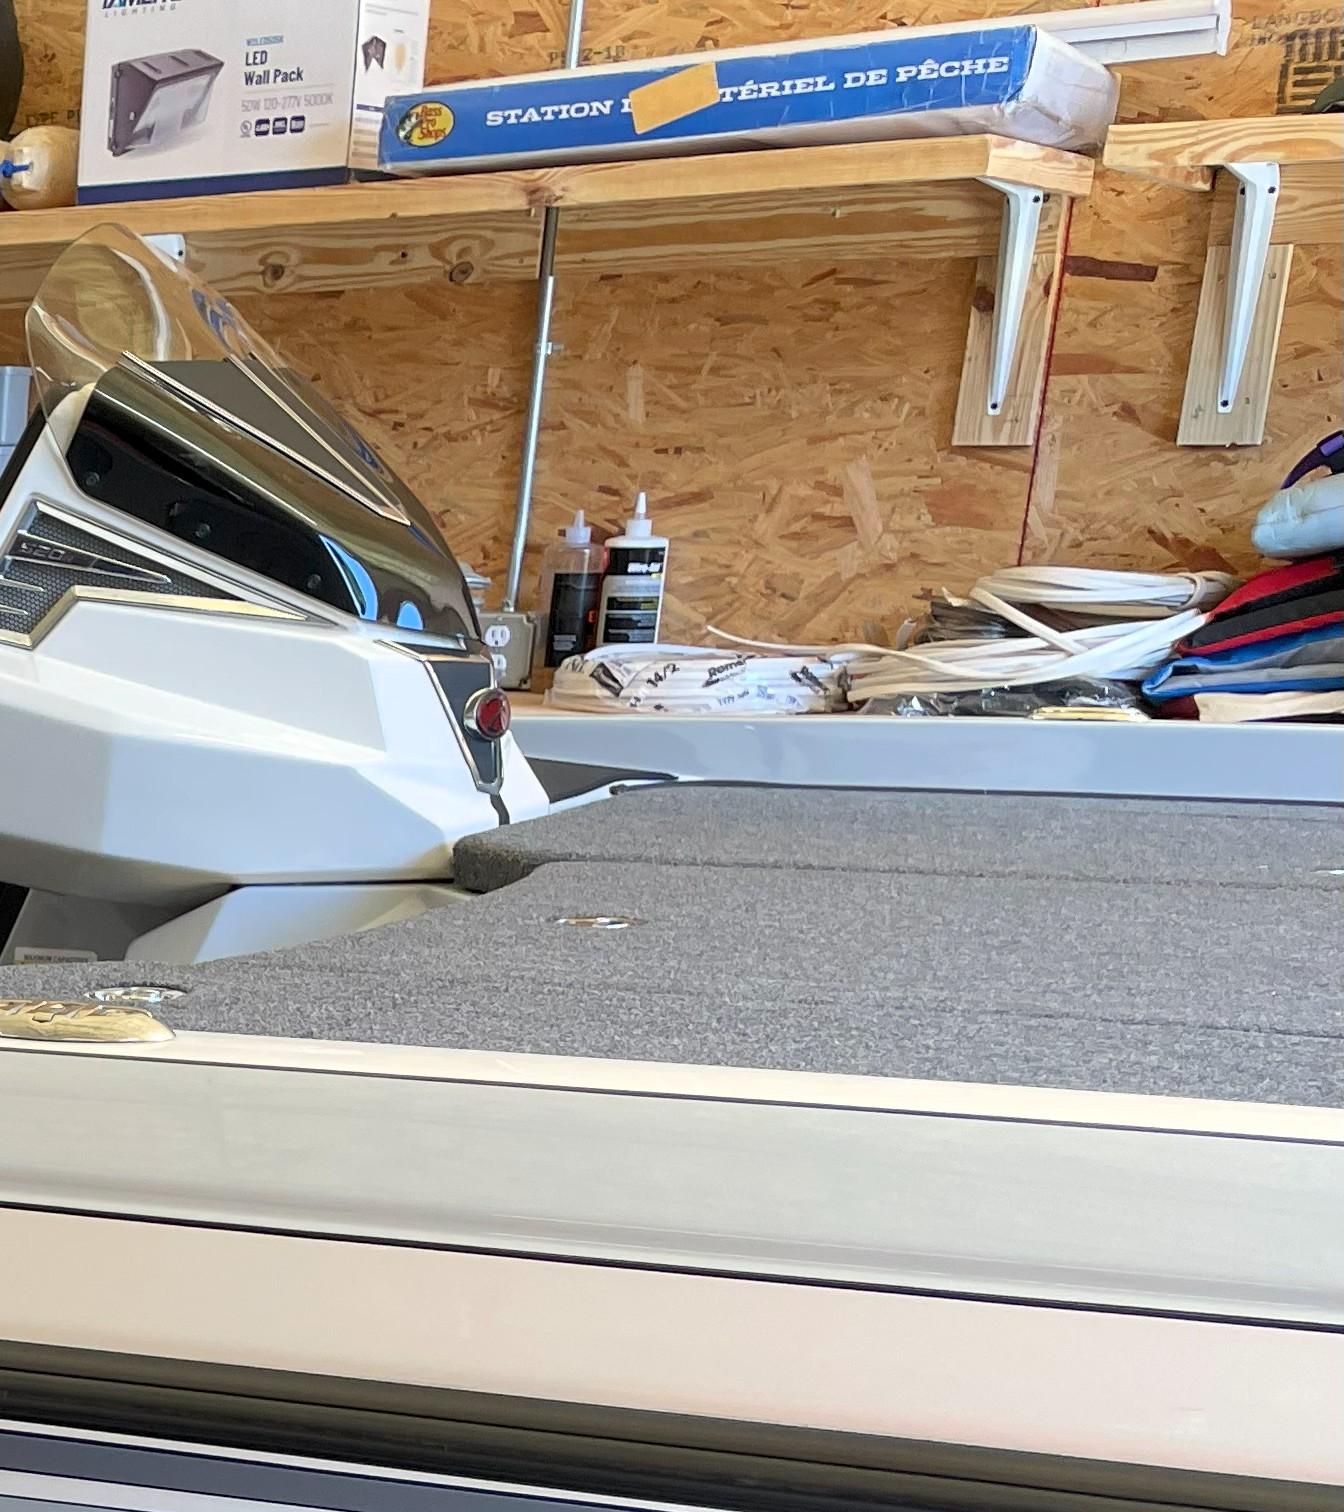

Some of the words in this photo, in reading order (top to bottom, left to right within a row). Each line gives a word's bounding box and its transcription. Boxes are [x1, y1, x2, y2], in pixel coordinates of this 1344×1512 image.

[245, 50, 268, 66] LED
[244, 70, 270, 86] Wall
[273, 66, 304, 84] Pack
[486, 100, 614, 127] STATION
[843, 69, 888, 89] DE
[895, 57, 1009, 82] PÊCHE
